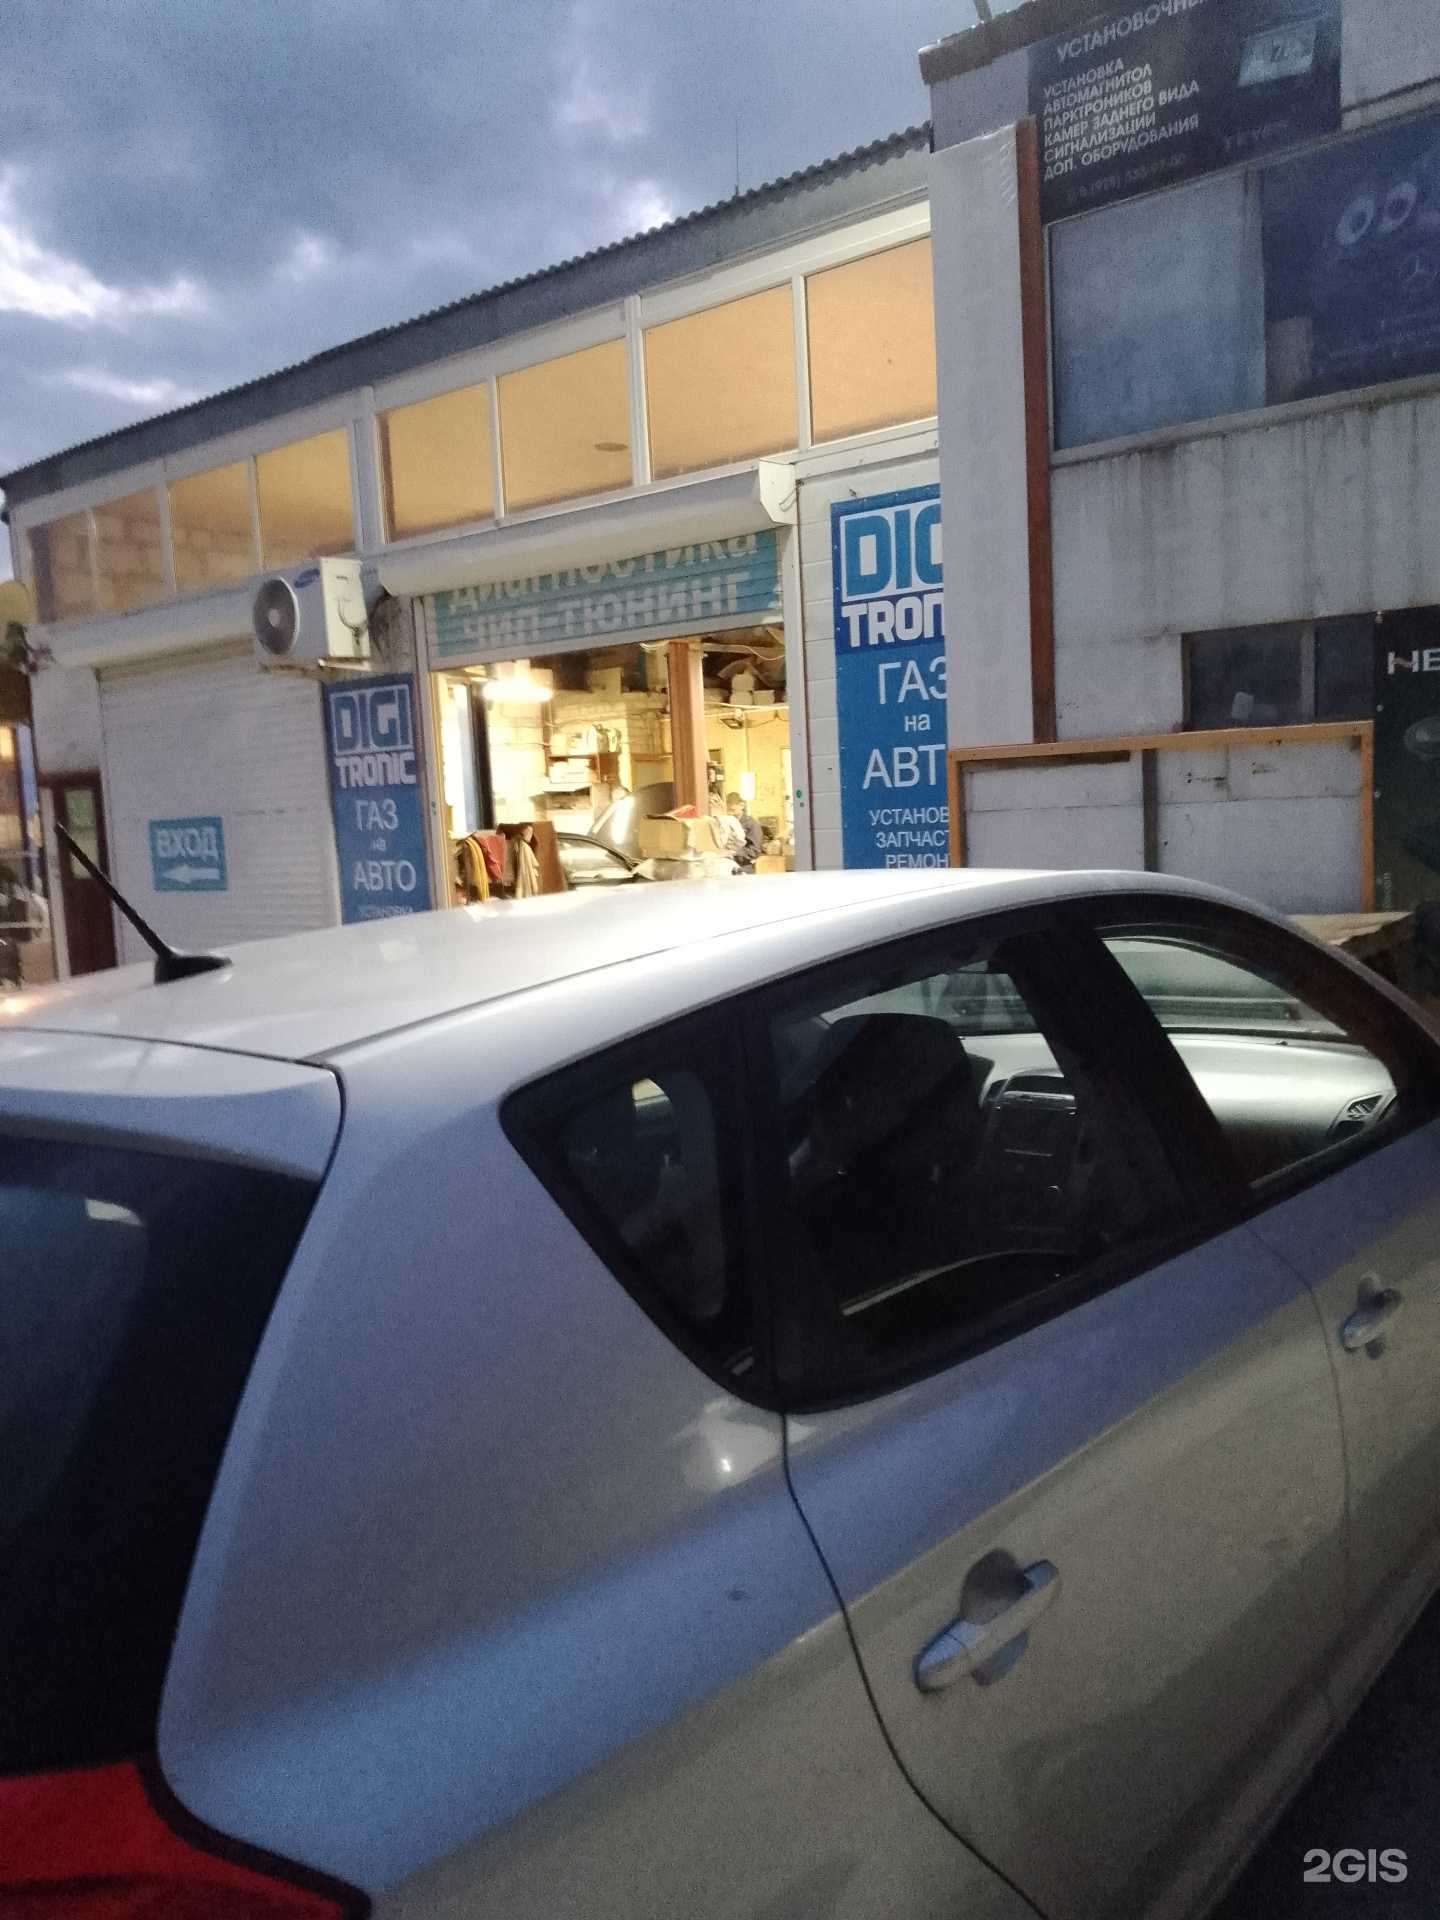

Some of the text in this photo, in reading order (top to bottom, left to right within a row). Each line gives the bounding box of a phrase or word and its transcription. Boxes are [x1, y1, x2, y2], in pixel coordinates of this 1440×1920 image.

[1043, 57, 1125, 98] УСТАНОВКА
[1043, 63, 1153, 116] АВТОМАГНИТОЛ
[1044, 80, 1153, 131] ПАРКТРОНИКОВ
[1044, 80, 1200, 147] КАМЕР ЗАДНЕГО ВИДА
[1044, 112, 1156, 163] СИГНАЛИЗАЦИИ
[1081, 114, 1199, 166] ОБОРУДОВАНИЯ
[878, 656, 947, 705] ГАЗ
[332, 685, 414, 753] DIGI
[904, 714, 931, 732] на
[334, 752, 417, 788] TRONIC
[354, 798, 399, 831] ГАЗ
[157, 825, 218, 863] ВХОД
[354, 860, 417, 892] АВТО
